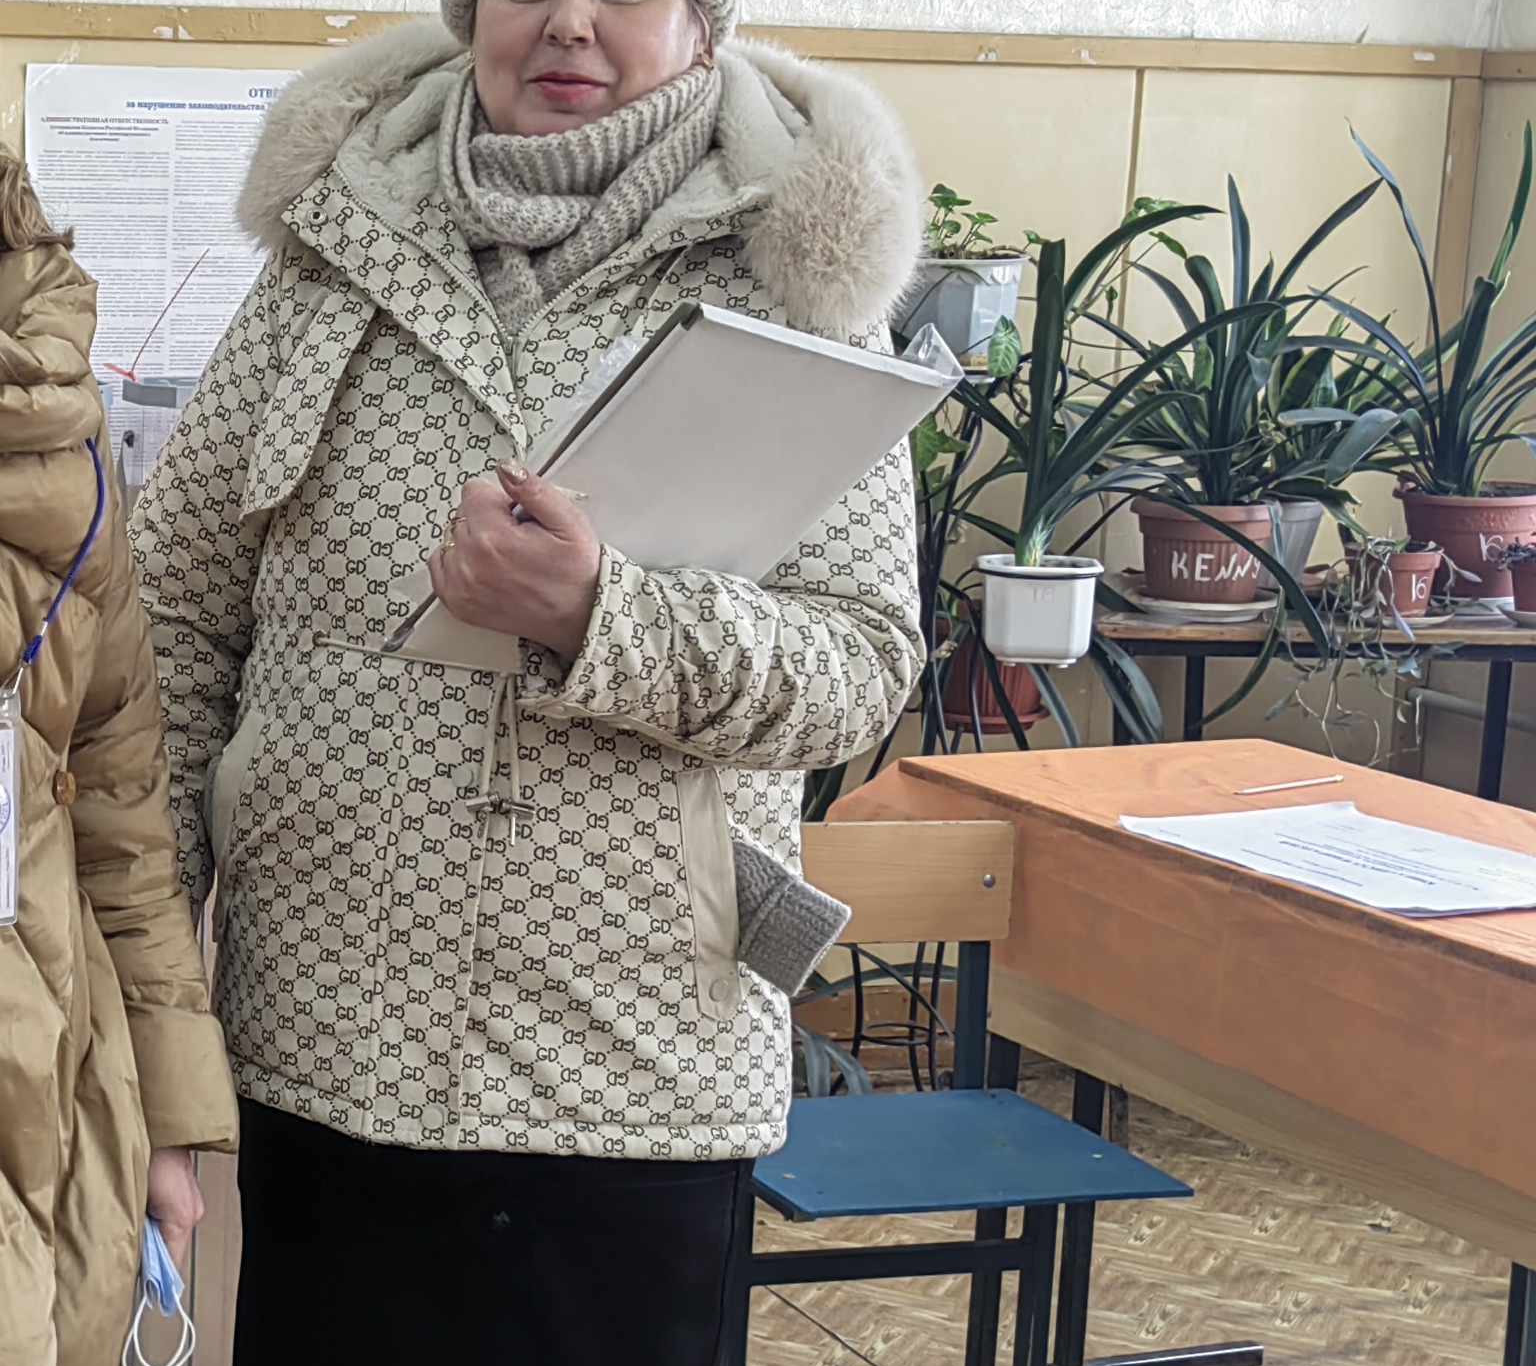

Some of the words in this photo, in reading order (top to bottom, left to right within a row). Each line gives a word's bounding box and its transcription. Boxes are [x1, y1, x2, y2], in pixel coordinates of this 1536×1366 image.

[137, 101, 187, 111] нарушение
[188, 101, 265, 111] законодательства
[1411, 573, 1428, 603] 16
